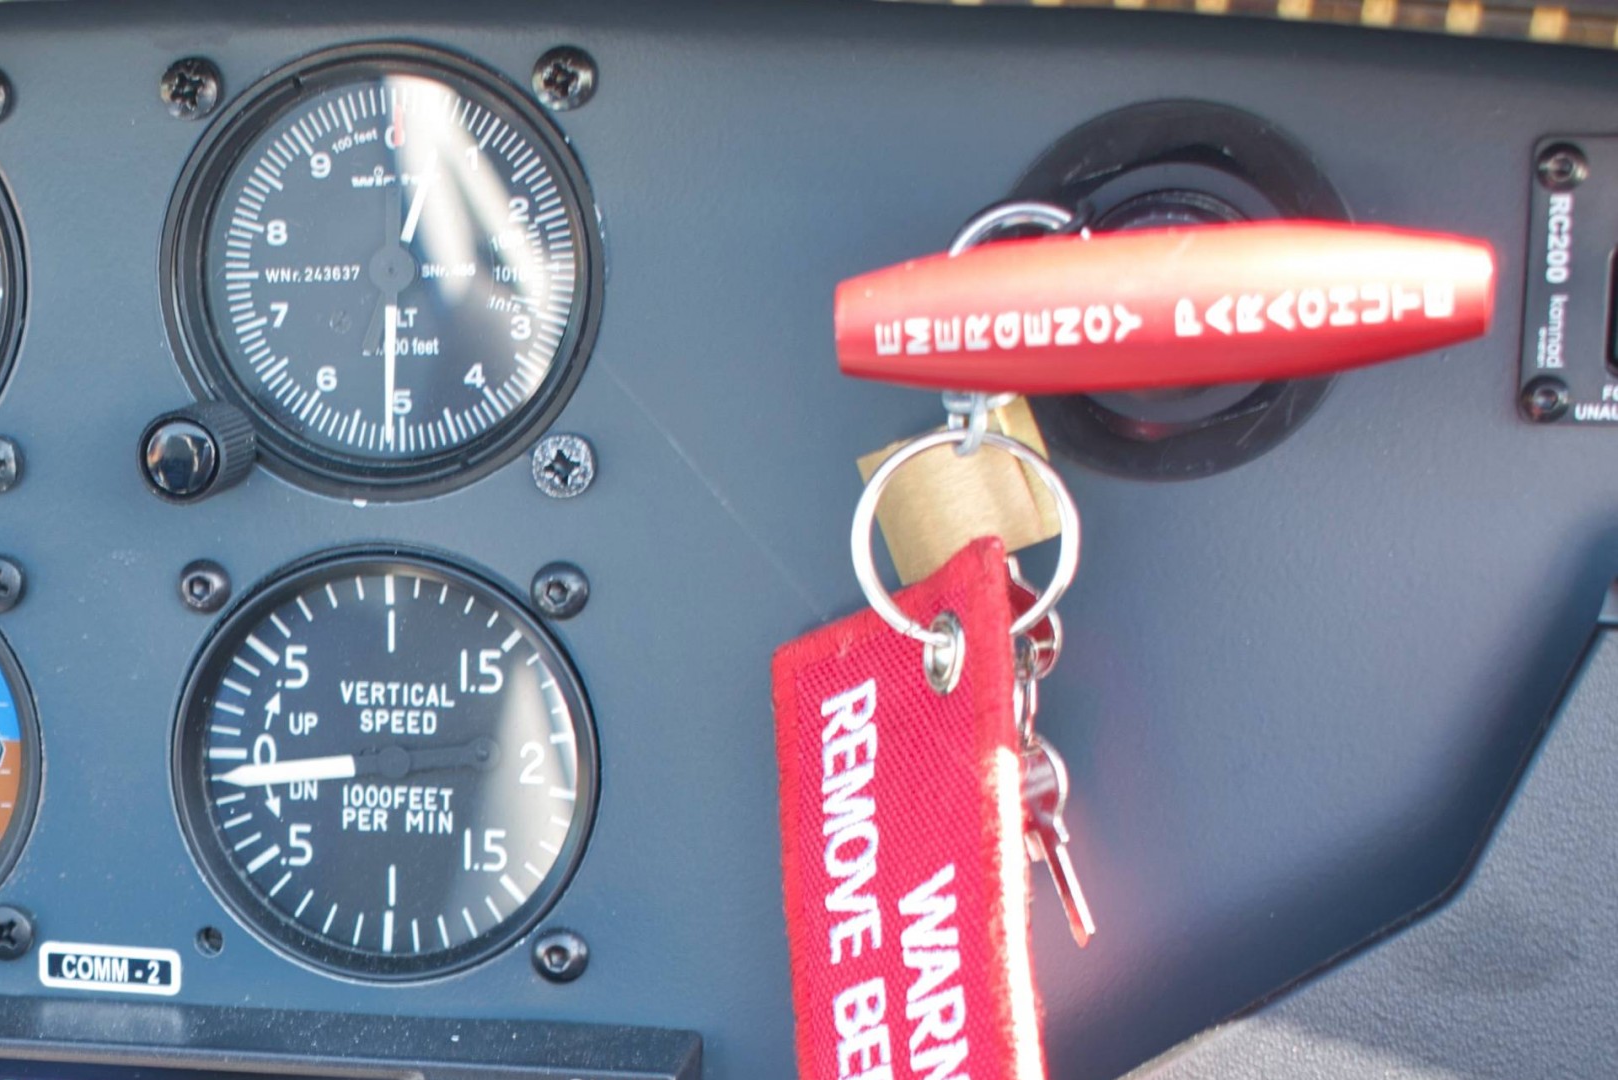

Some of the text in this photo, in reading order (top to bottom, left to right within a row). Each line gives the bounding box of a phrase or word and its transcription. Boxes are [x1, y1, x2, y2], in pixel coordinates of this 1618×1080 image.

[1546, 193, 1572, 284] RC200
[1546, 294, 1568, 369] kannad
[341, 681, 455, 707] VERTICAL
[289, 713, 317, 735] UP
[360, 710, 436, 734] SPEED
[519, 742, 545, 784] 2
[342, 785, 453, 811] 1000FEET
[342, 809, 453, 834] PER MIN
[820, 678, 883, 962] REMOVE
[62, 955, 160, 984] COMM 2
